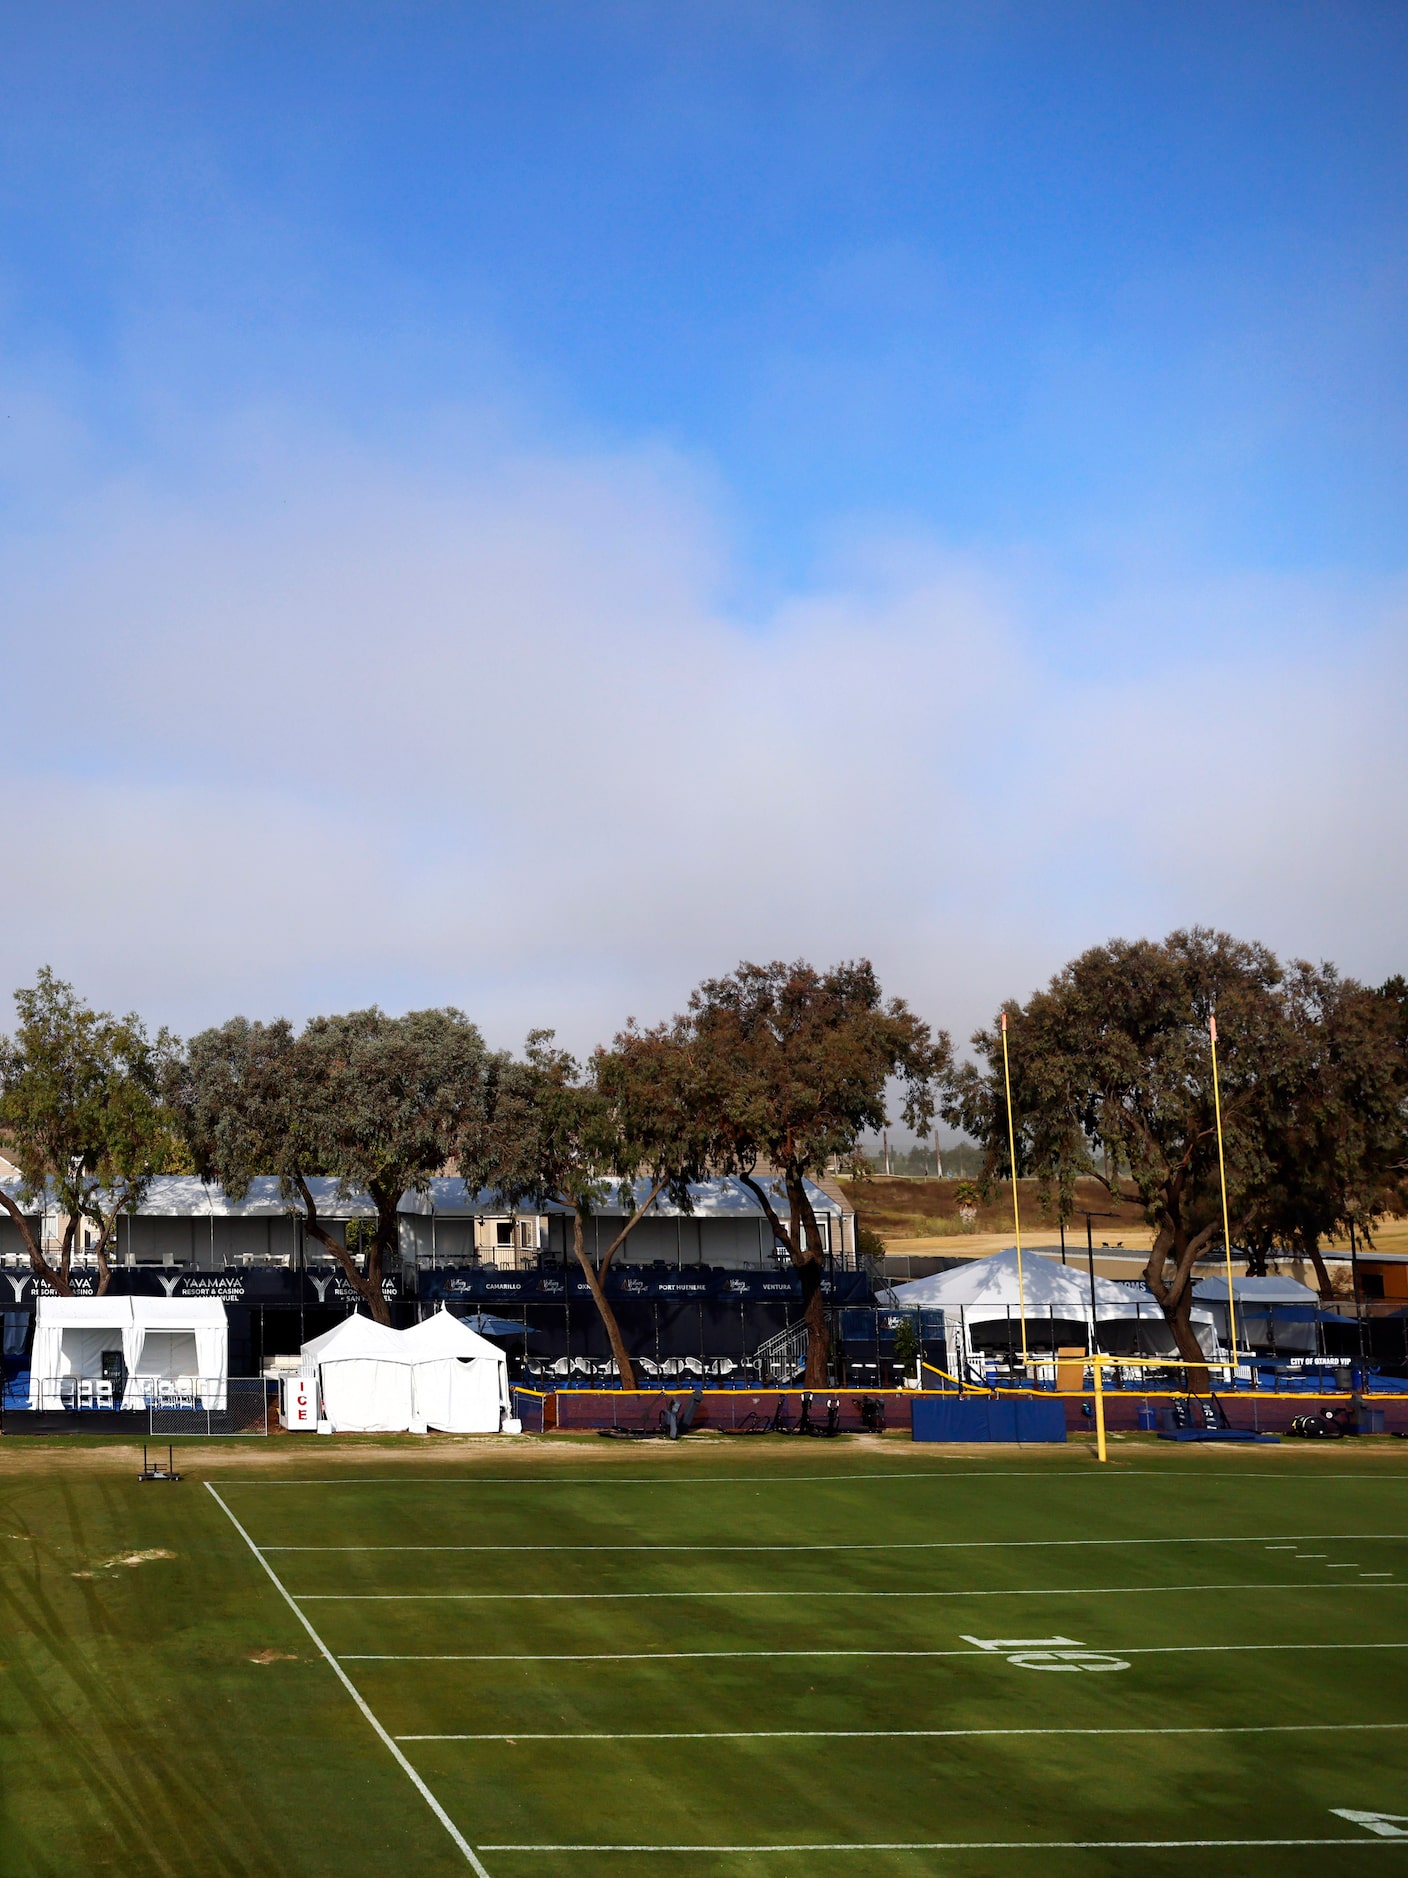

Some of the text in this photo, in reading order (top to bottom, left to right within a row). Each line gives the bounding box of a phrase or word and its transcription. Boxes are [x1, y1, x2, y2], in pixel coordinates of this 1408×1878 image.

[1290, 1357, 1305, 1366] CITY
[1305, 1357, 1314, 1366] OF
[1340, 1357, 1352, 1366] VIP
[297, 1381, 308, 1421] ICE
[958, 1634, 1133, 1673] 10
